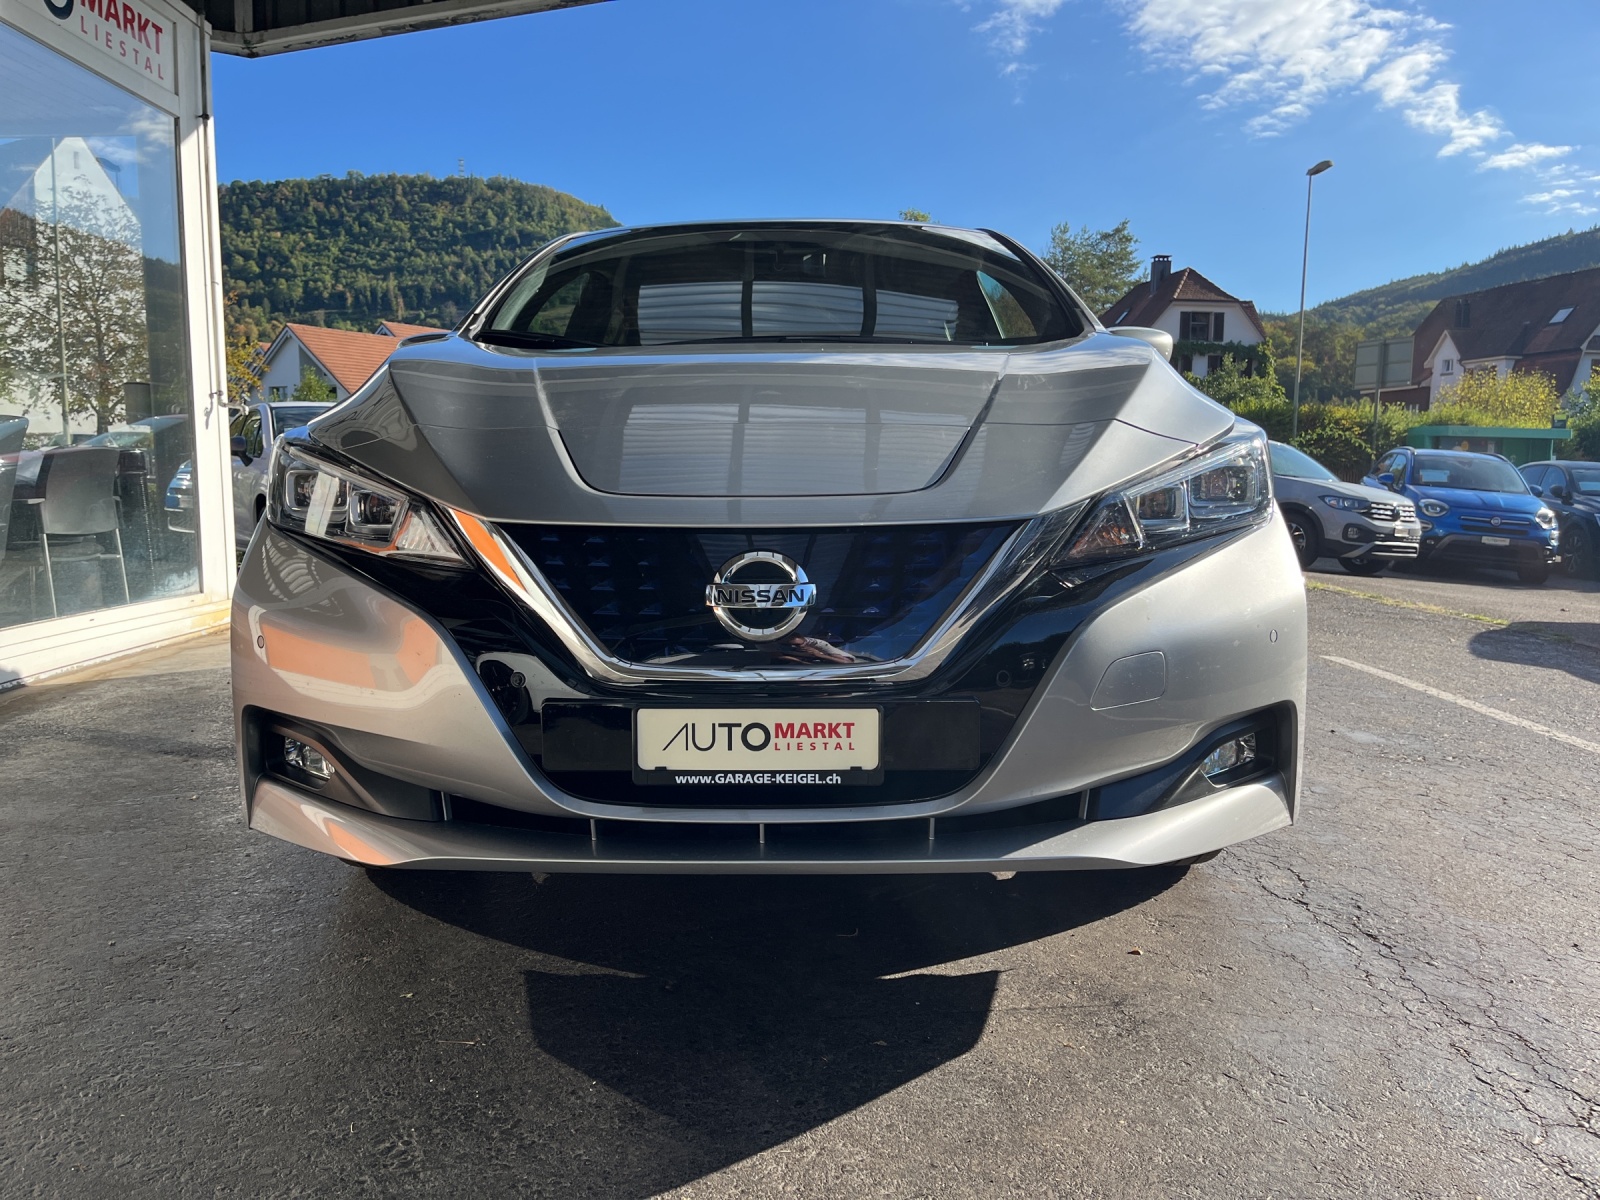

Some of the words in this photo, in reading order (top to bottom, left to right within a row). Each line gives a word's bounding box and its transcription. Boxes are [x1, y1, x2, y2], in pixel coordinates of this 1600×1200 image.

[80, 15, 164, 80] LIESTAL
[716, 588, 805, 603] NISSAN
[662, 722, 771, 752] AUTO
[774, 722, 855, 739] MARKT
[774, 742, 855, 751] LIESTAL
[675, 773, 841, 785] www.GARAGE-KEIGEL.ch
